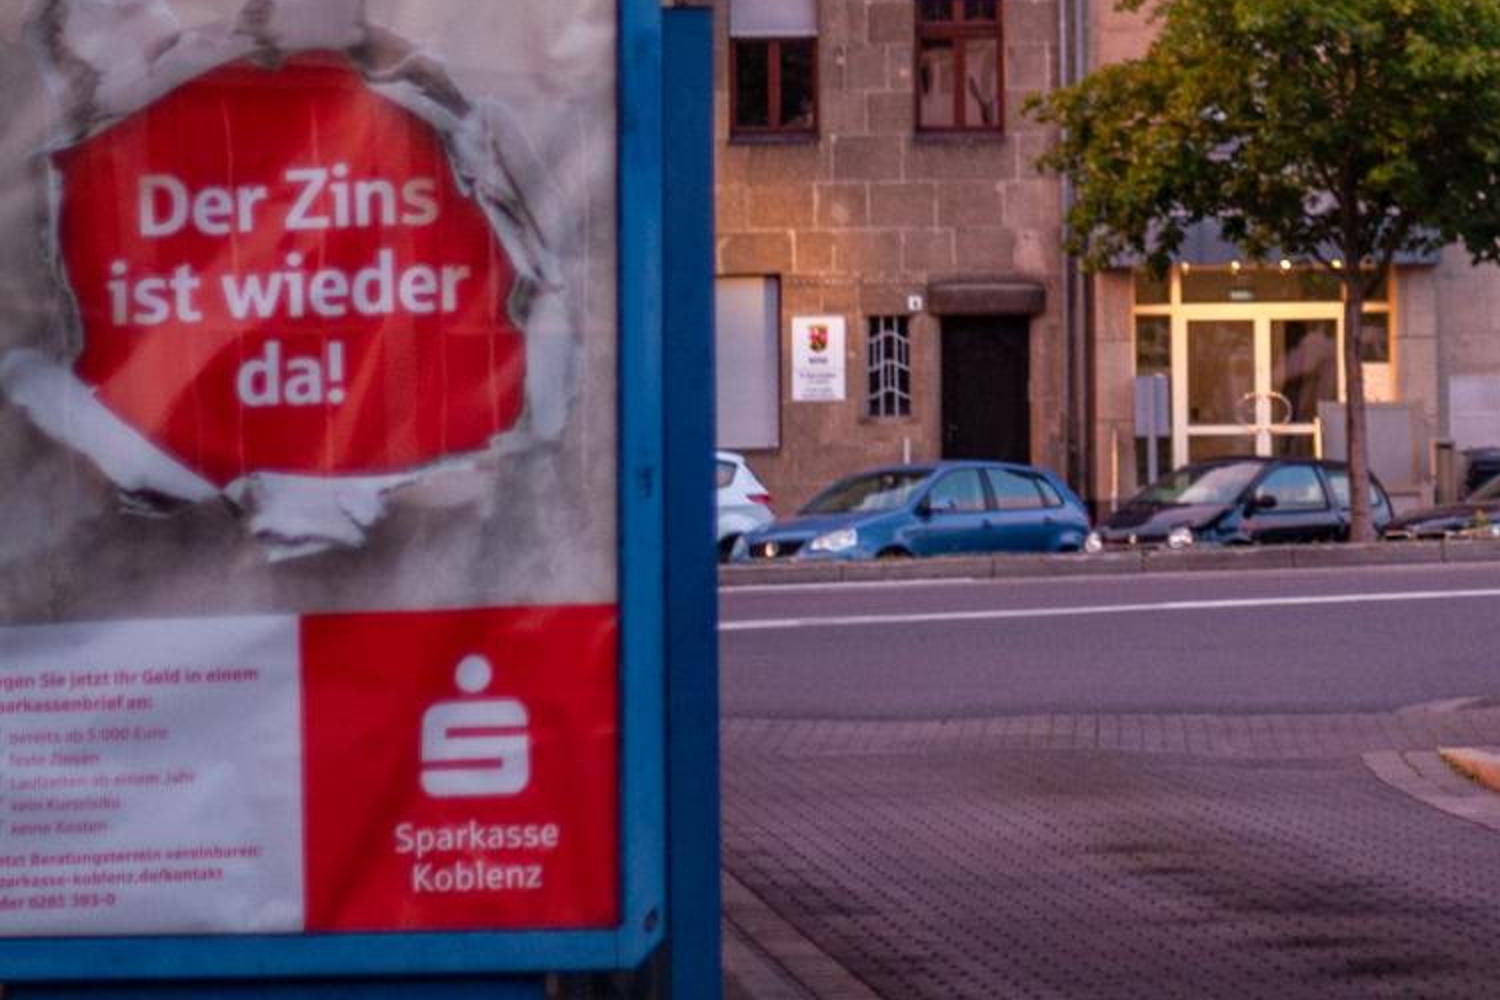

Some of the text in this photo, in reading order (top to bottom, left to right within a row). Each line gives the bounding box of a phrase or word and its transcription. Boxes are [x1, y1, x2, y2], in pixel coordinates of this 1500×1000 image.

[137, 162, 439, 238] Der Zins
[107, 248, 471, 327] ist wieder
[236, 339, 346, 407] da!
[39, 671, 66, 688] Sie
[69, 669, 109, 690] jetzt
[142, 667, 180, 685] Geld
[185, 667, 202, 682] in
[205, 666, 259, 683] einem
[394, 820, 561, 857] Sparkasse
[411, 857, 544, 893] Koblenz
